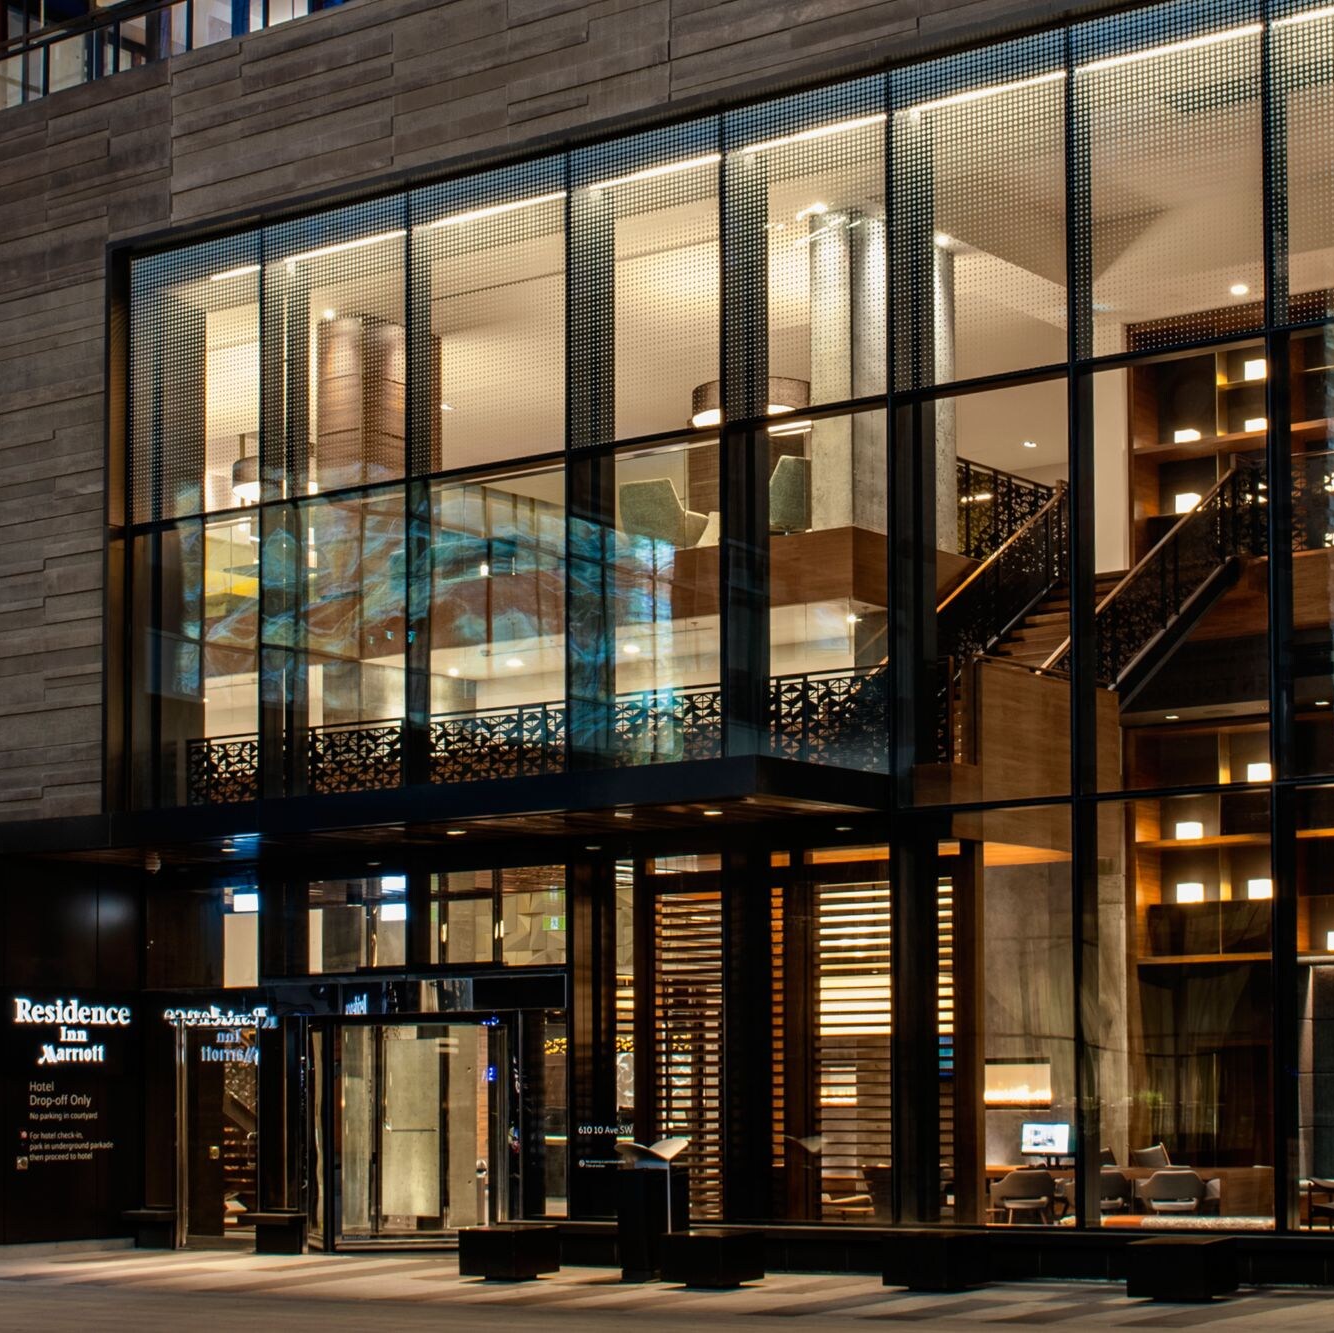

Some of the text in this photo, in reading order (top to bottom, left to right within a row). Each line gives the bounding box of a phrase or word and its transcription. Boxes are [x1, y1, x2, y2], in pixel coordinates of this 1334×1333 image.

[14, 998, 131, 1025] Residence
[60, 1026, 88, 1042] Inn
[37, 1044, 104, 1065] Marriott
[29, 1081, 55, 1092] Hotel
[29, 1094, 92, 1108] Drop-off Only
[29, 1112, 39, 1120] No
[39, 1112, 63, 1121] parking
[70, 1112, 98, 1121] courtyard
[578, 1124, 634, 1135] 610 10 Ave SW
[29, 1132, 39, 1140] For
[40, 1131, 56, 1139] hotel
[29, 1140, 114, 1152] park in underground parkade
[29, 1151, 93, 1162] then proceed to hotel
